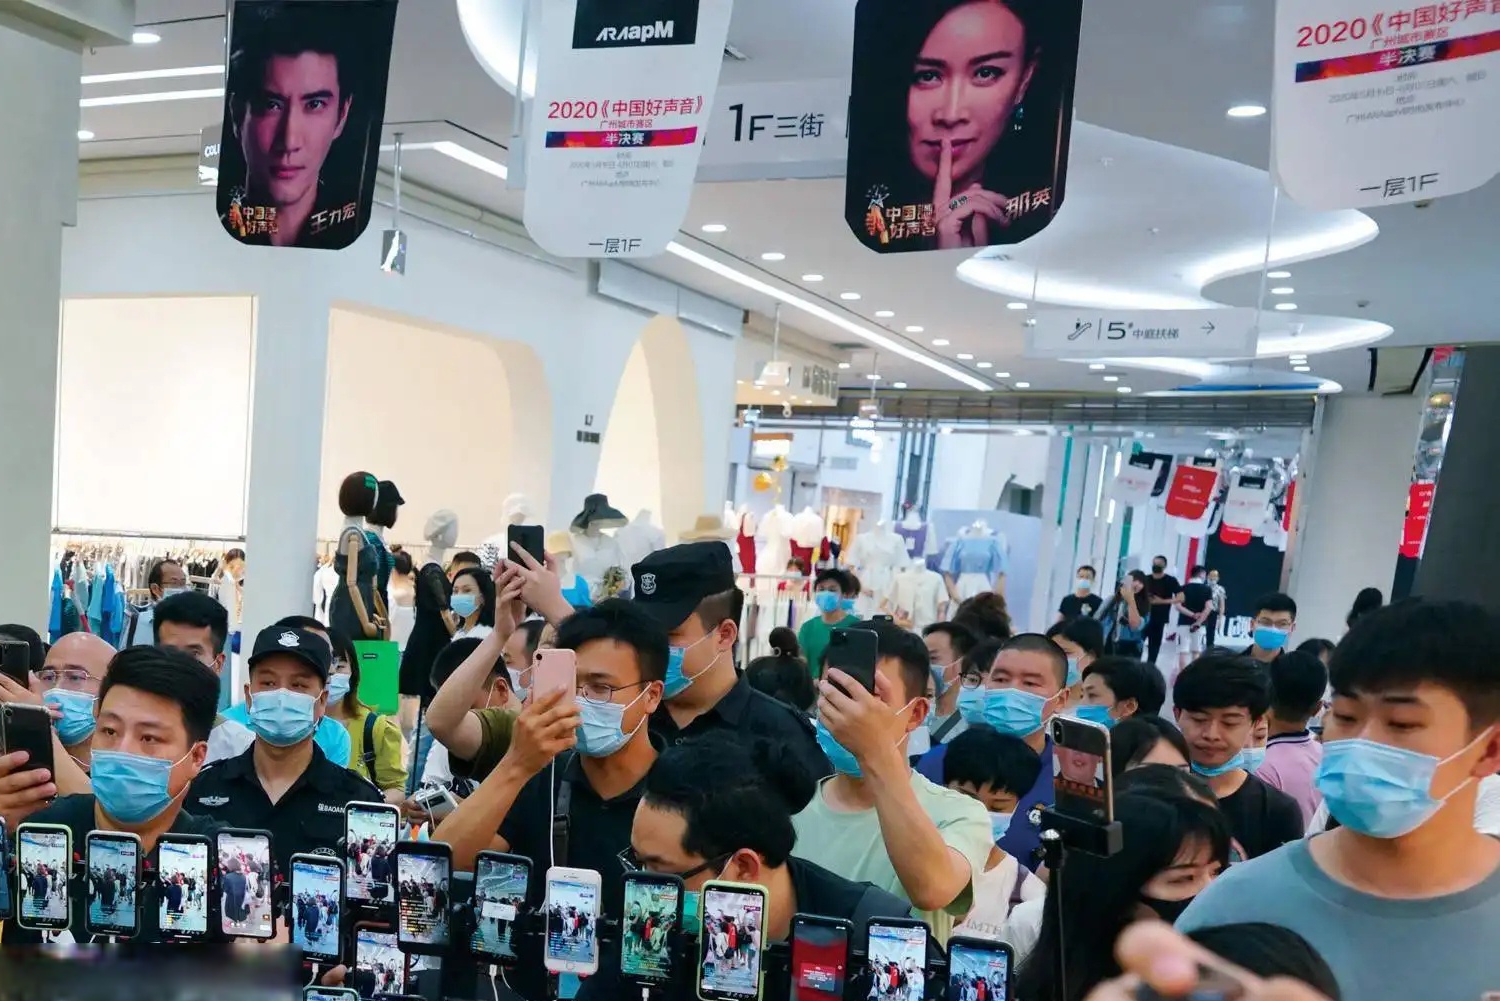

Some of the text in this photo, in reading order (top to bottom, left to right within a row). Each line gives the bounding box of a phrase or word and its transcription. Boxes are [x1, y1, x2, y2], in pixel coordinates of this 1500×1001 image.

[1379, 45, 1438, 66] 半决赛
[604, 131, 646, 146] 半决赛
